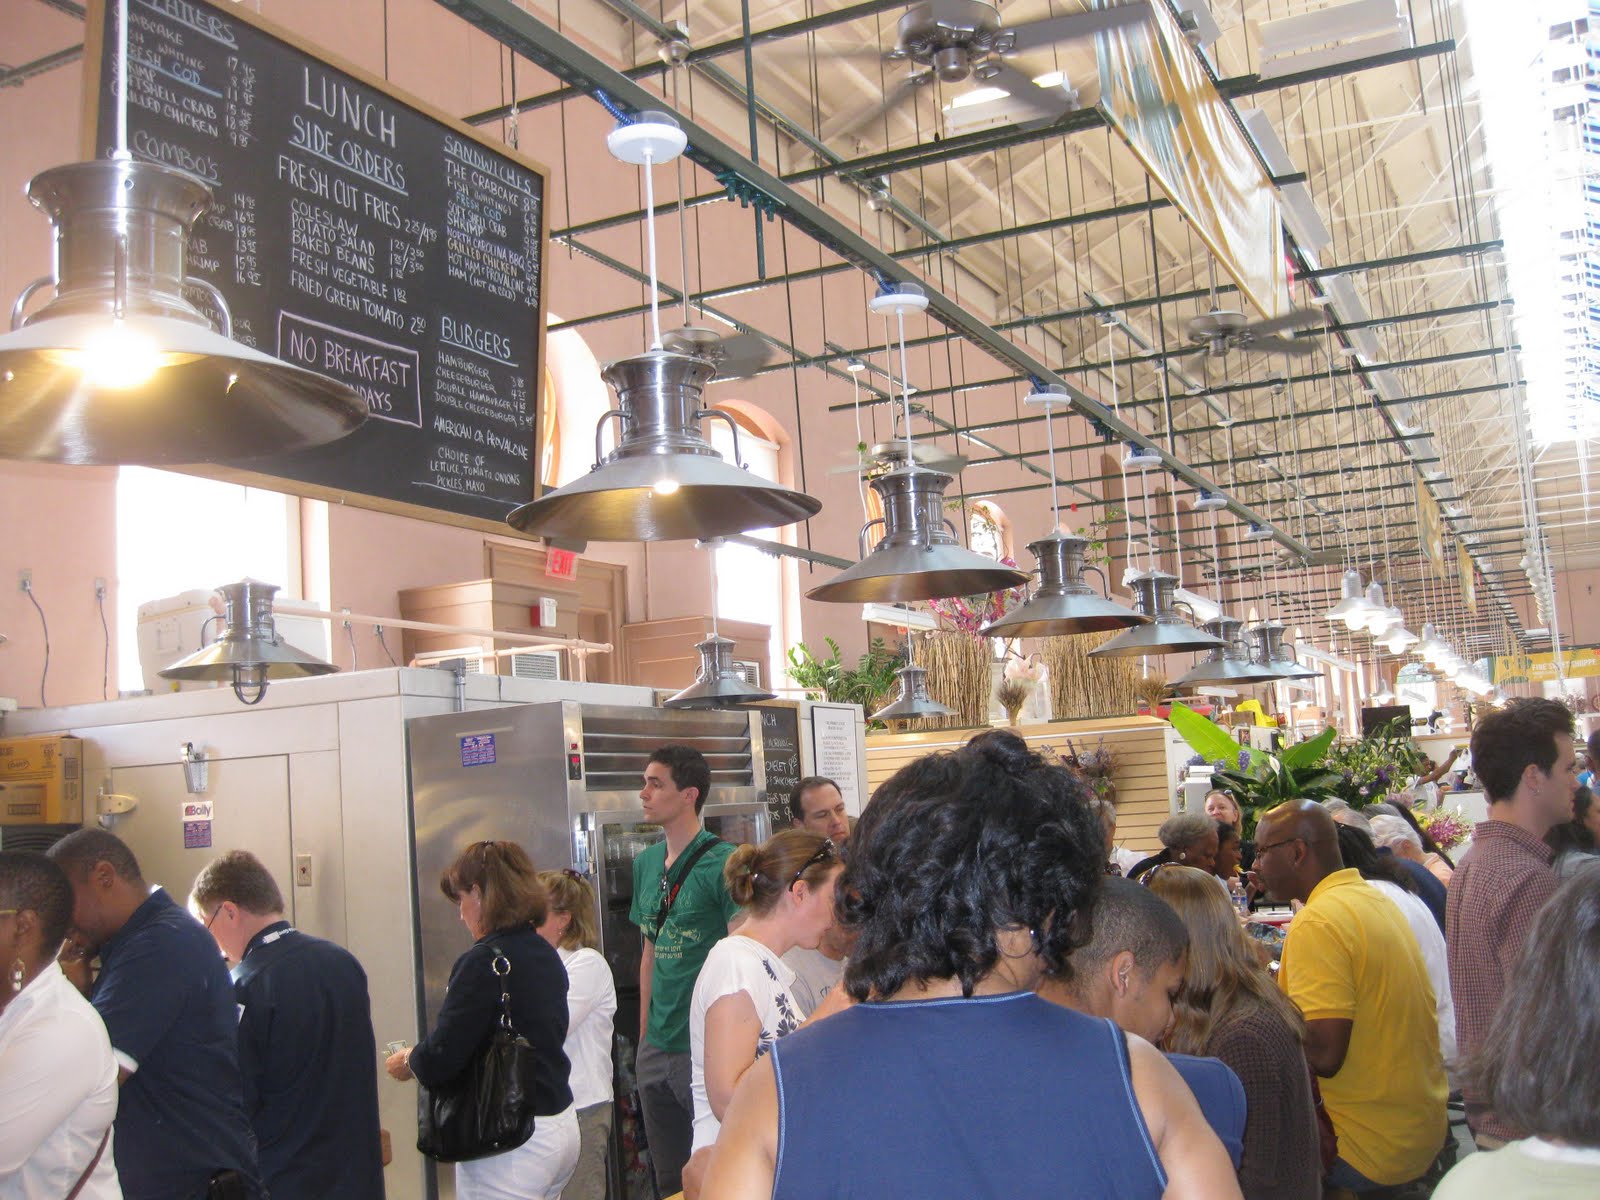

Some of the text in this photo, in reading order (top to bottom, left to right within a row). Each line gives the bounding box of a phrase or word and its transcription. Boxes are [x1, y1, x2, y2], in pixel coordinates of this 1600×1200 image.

[173, 62, 200, 85] COD
[164, 104, 218, 137] CHICKEN
[183, 97, 217, 119] CRAB
[304, 67, 396, 148] LUNCH
[134, 130, 218, 181] COMBO'S
[293, 115, 406, 190] SIDE ORDERS
[444, 135, 531, 194] SANDWICHES
[279, 155, 329, 199] FRESH
[334, 179, 359, 212] CUT
[364, 192, 401, 229] FRIES
[445, 158, 466, 180] THE
[471, 171, 518, 206] CRABCAKE
[447, 176, 469, 196] FISH
[291, 197, 359, 238] COLESLAW
[447, 200, 466, 220] SOFT
[468, 209, 487, 231] SHELL
[488, 219, 507, 238] CRAB
[447, 212, 484, 237] SHRIMP
[456, 191, 480, 212] FRESH
[483, 205, 501, 221] COD
[292, 212, 336, 242] POTATO
[340, 233, 376, 257] SALAD
[292, 229, 331, 255] BAKED
[336, 246, 375, 274] BEANS
[446, 225, 472, 246] NORTH
[473, 238, 507, 262] CAROLINA
[508, 249, 525, 272] BBQ
[292, 247, 328, 276] FRESH
[332, 265, 388, 298] VEGETABLE
[447, 237, 481, 261] GRILLED
[482, 254, 517, 277] CHICKEN
[447, 250, 462, 268] HOT
[464, 257, 481, 275] HAM
[448, 265, 467, 281] HAM
[291, 270, 323, 298] FRIED
[325, 286, 360, 312] GREEN
[362, 298, 404, 329] TOMATO
[441, 316, 512, 359] BURGERS
[291, 329, 411, 388] NO BREAKFAST
[438, 350, 491, 382] HAMBURGER
[435, 366, 497, 394] CHEESEBURGER
[436, 379, 466, 397] DOUBLE
[469, 390, 513, 411] HAMBURGER
[434, 391, 463, 409] DOUBLE
[464, 402, 518, 428] CHEESEBURGER
[433, 415, 472, 440] AMERICAN
[474, 430, 485, 444] OR
[437, 446, 485, 467] CHOICE OF
[465, 480, 486, 493] MAYO
[494, 472, 520, 486] ONIONS
[552, 550, 576, 576] EXIT
